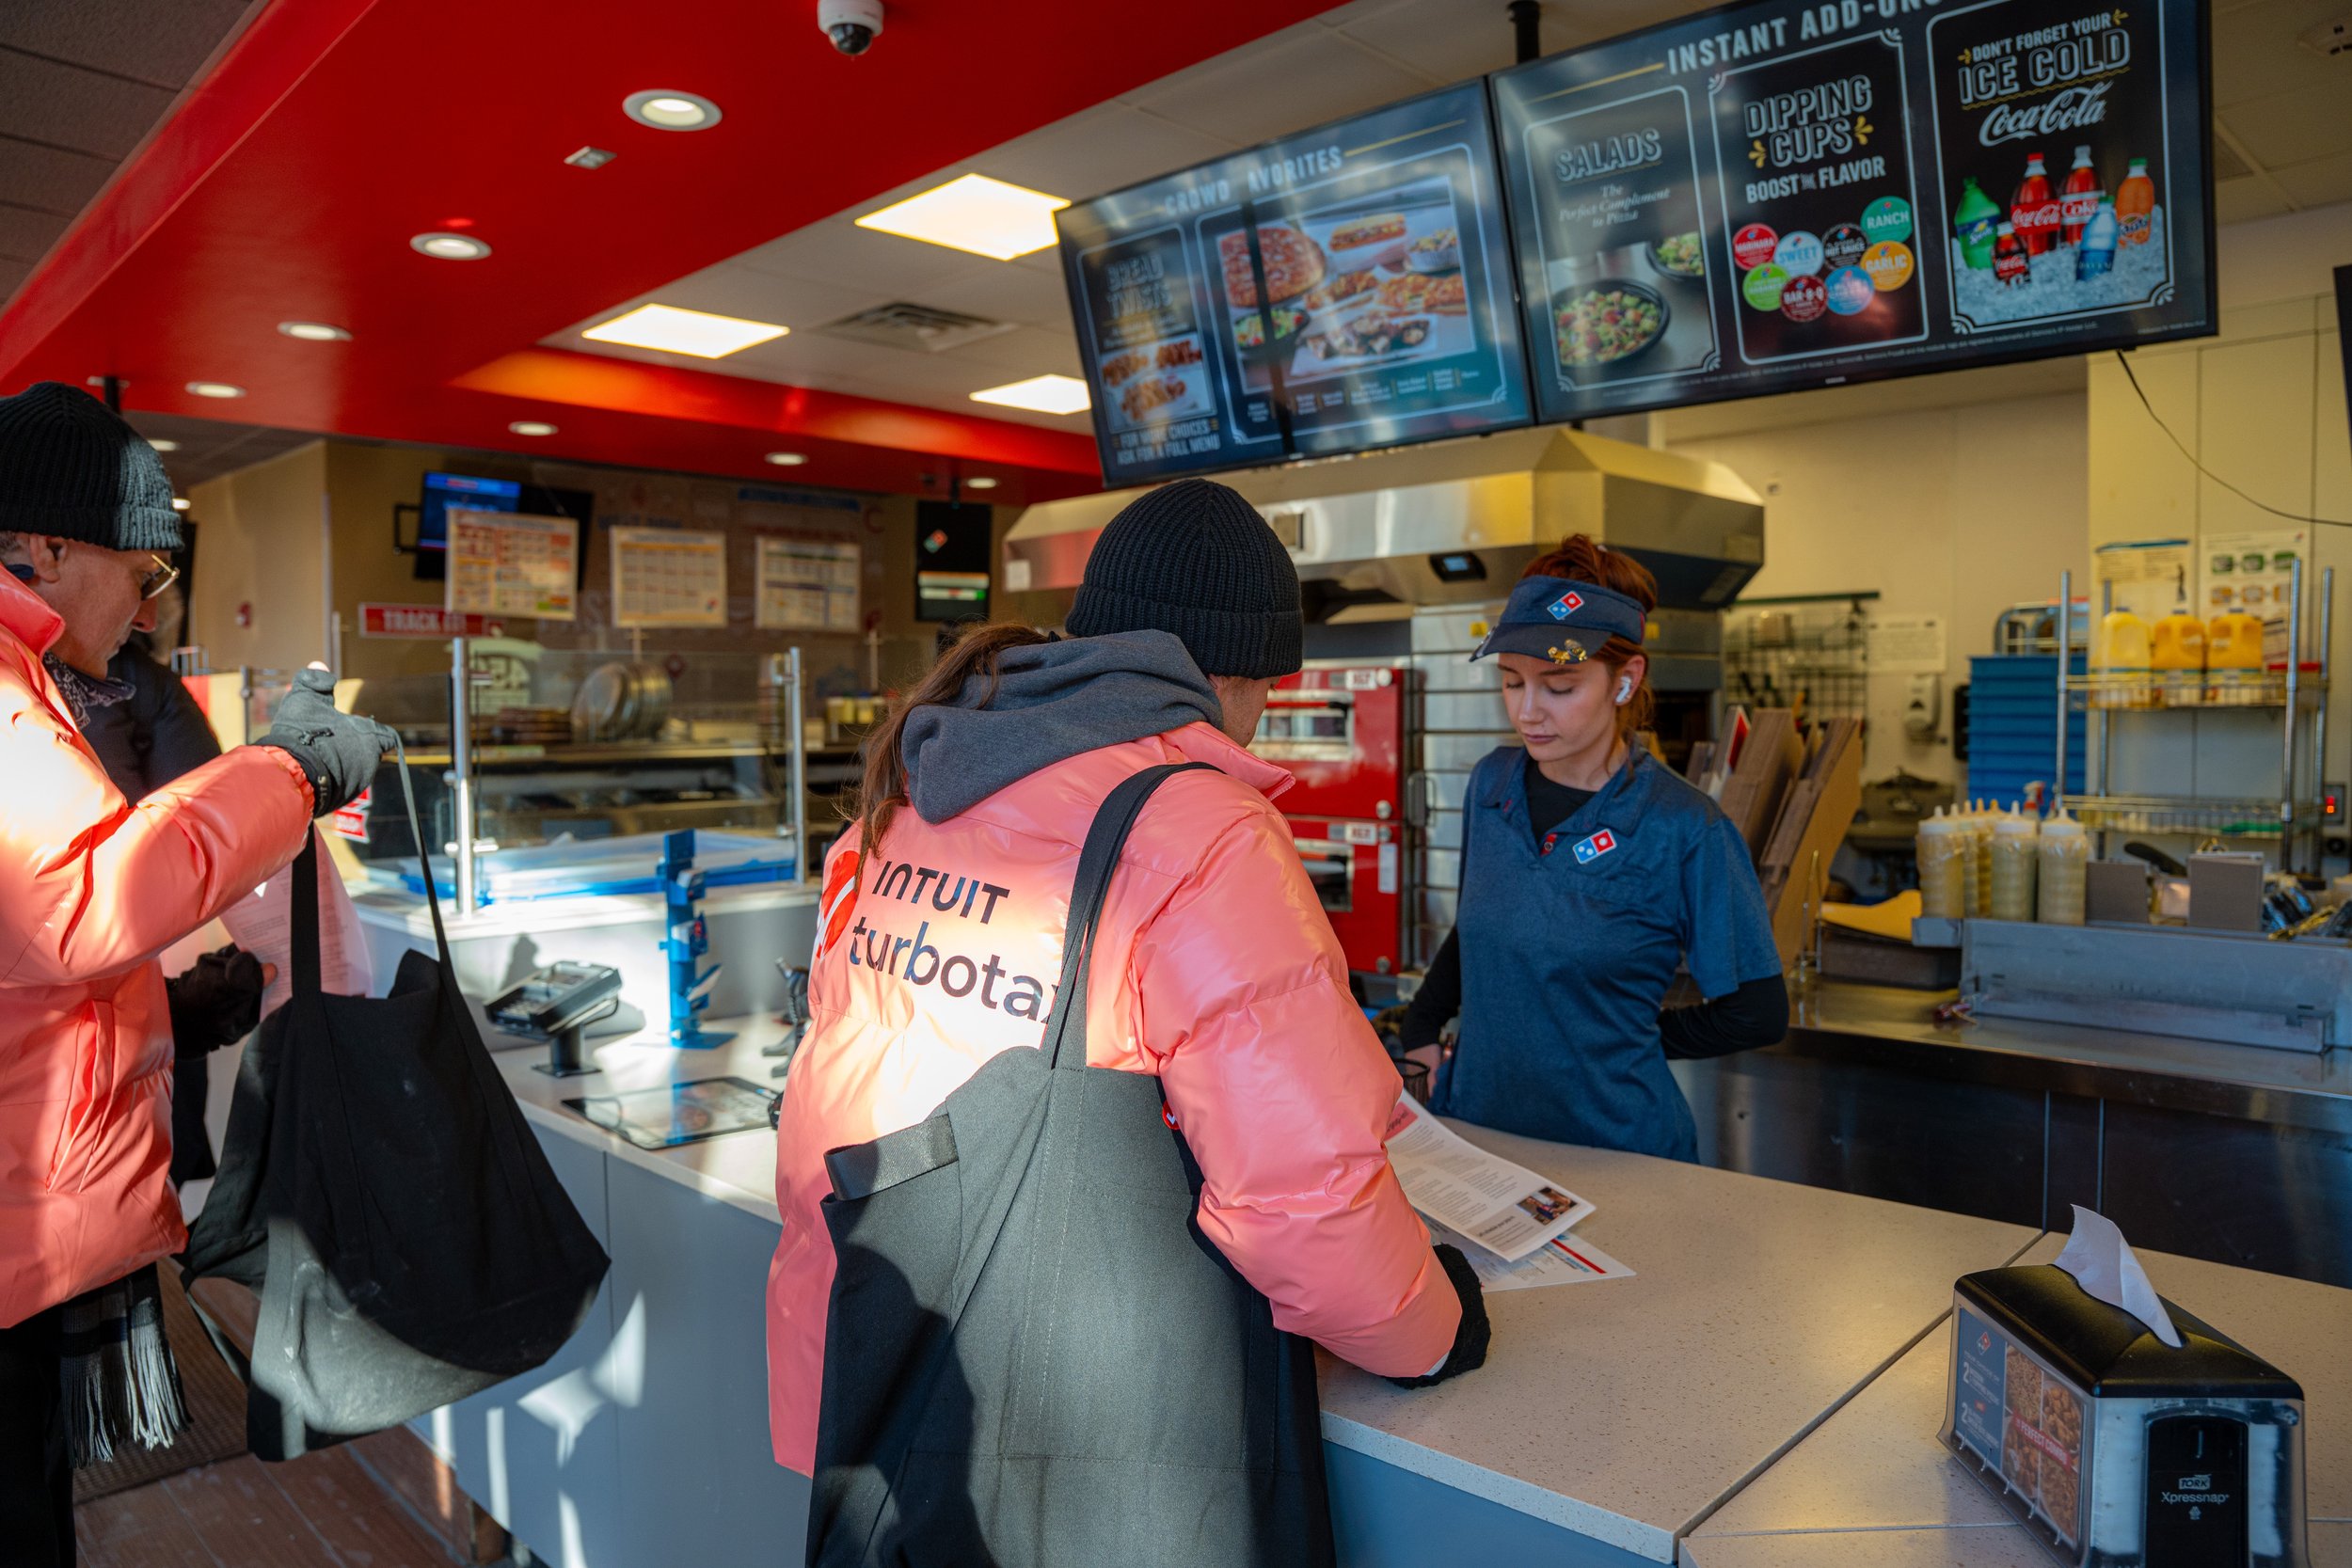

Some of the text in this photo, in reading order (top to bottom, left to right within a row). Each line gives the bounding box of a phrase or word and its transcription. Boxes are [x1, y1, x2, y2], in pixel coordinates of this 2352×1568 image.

[1668, 0, 1942, 75] INSTANT ADD-ON
[1972, 12, 2112, 62] DON'T FORGET YOUR
[1958, 28, 2131, 104] ICE COLD
[1743, 74, 1873, 138] DIPPING
[1979, 79, 2114, 147] Coca-Cola
[1554, 128, 1662, 182] SALADS
[1769, 117, 1853, 167] CUPS
[1244, 146, 1343, 194] AVORITES
[1745, 173, 1801, 204] BOOST
[1818, 155, 1886, 189] FLAVOR
[1867, 211, 1910, 230] RANCH
[1778, 246, 1819, 264] SWEET
[1866, 254, 1908, 273] GARLIC
[1783, 286, 1824, 305] BAR-B-Q
[872, 861, 1010, 925] INTUIT
[850, 916, 1059, 1024] turbota
[2181, 1479, 2209, 1488] TORK
